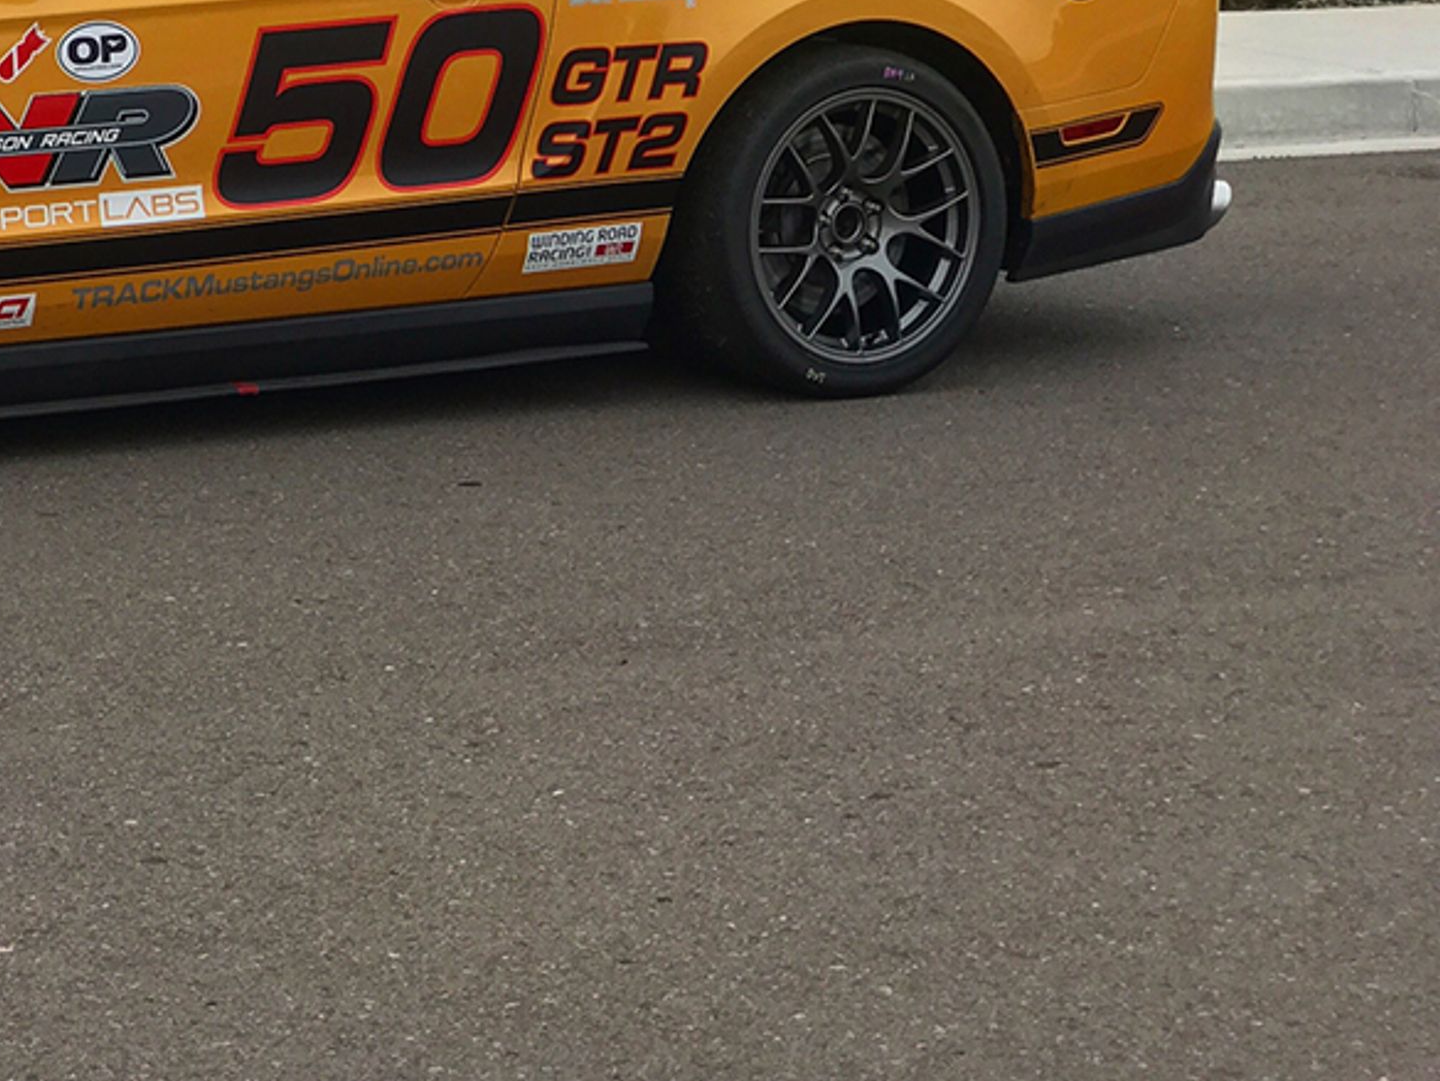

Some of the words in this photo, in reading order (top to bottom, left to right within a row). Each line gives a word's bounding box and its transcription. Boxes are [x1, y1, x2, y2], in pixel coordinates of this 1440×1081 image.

[67, 33, 127, 65] OP
[551, 41, 710, 107] GTR
[213, 3, 548, 211] 50
[40, 128, 121, 149] RACING
[530, 112, 689, 178] ST2
[531, 230, 594, 248] WINDING
[598, 225, 638, 241] ROAD
[72, 250, 483, 310] TRACKMustangsOnline.com
